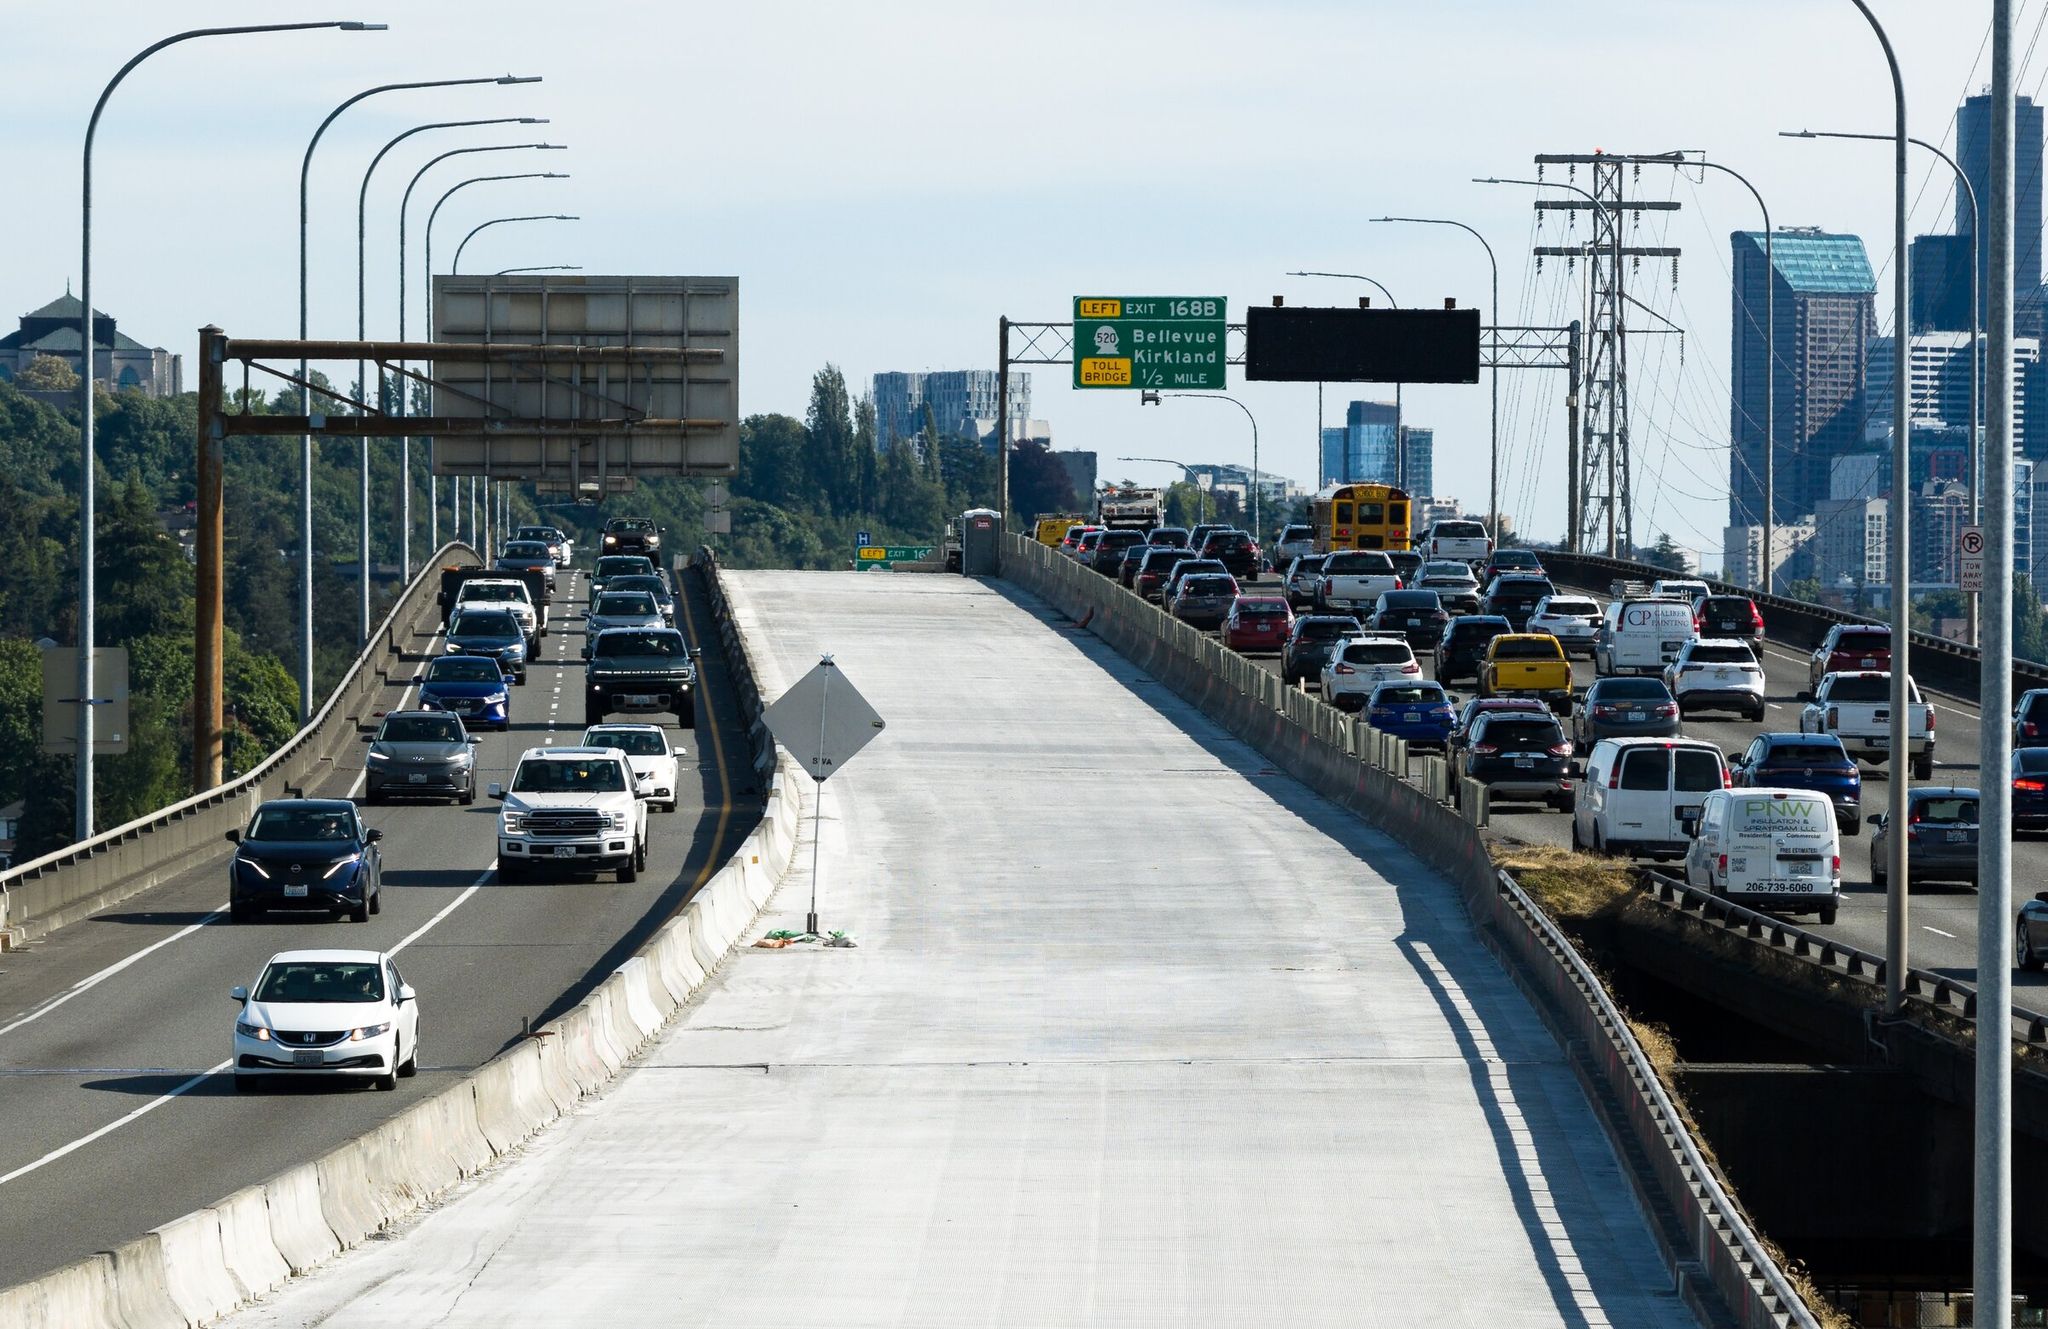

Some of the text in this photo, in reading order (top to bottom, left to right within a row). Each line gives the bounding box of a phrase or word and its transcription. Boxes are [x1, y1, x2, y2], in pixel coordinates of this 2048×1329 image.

[1083, 300, 1216, 316] LEFT EXIT 168B
[1097, 332, 1116, 343] 520
[1133, 329, 1216, 343] Bellevue
[1134, 349, 1216, 363] Kirkland
[1092, 361, 1121, 370] TOLL
[1085, 372, 1128, 382] BRIDGE
[1174, 373, 1207, 384] MILE
[862, 549, 883, 557] LEFT
[1628, 610, 1651, 626] CP
[1746, 801, 1814, 817] PNW
[1746, 882, 1814, 892] 206-739-6060
